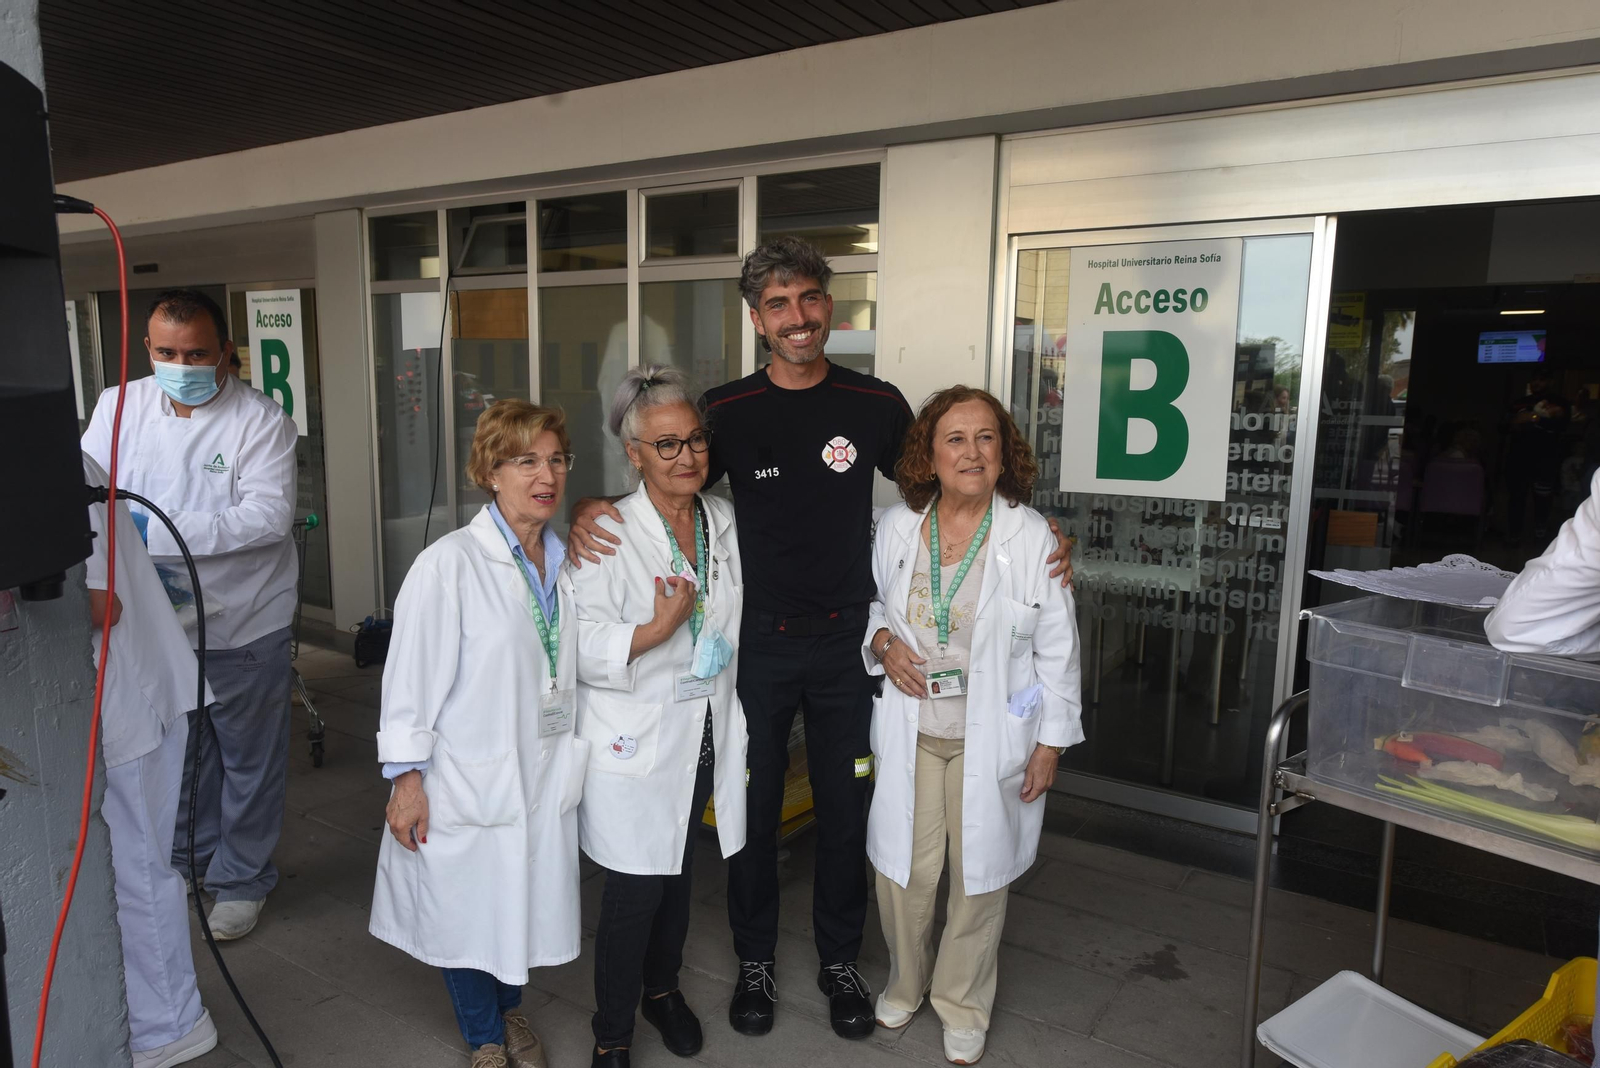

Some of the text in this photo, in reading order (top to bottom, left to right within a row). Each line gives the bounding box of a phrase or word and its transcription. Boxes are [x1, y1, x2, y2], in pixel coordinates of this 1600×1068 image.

[1088, 253, 1222, 270] Hospital Universitario Reina Sofía
[1094, 283, 1209, 315] Acceso
[256, 309, 292, 328] Acceso
[260, 339, 294, 418] B
[1096, 330, 1190, 482] B
[754, 467, 780, 480] 3415
